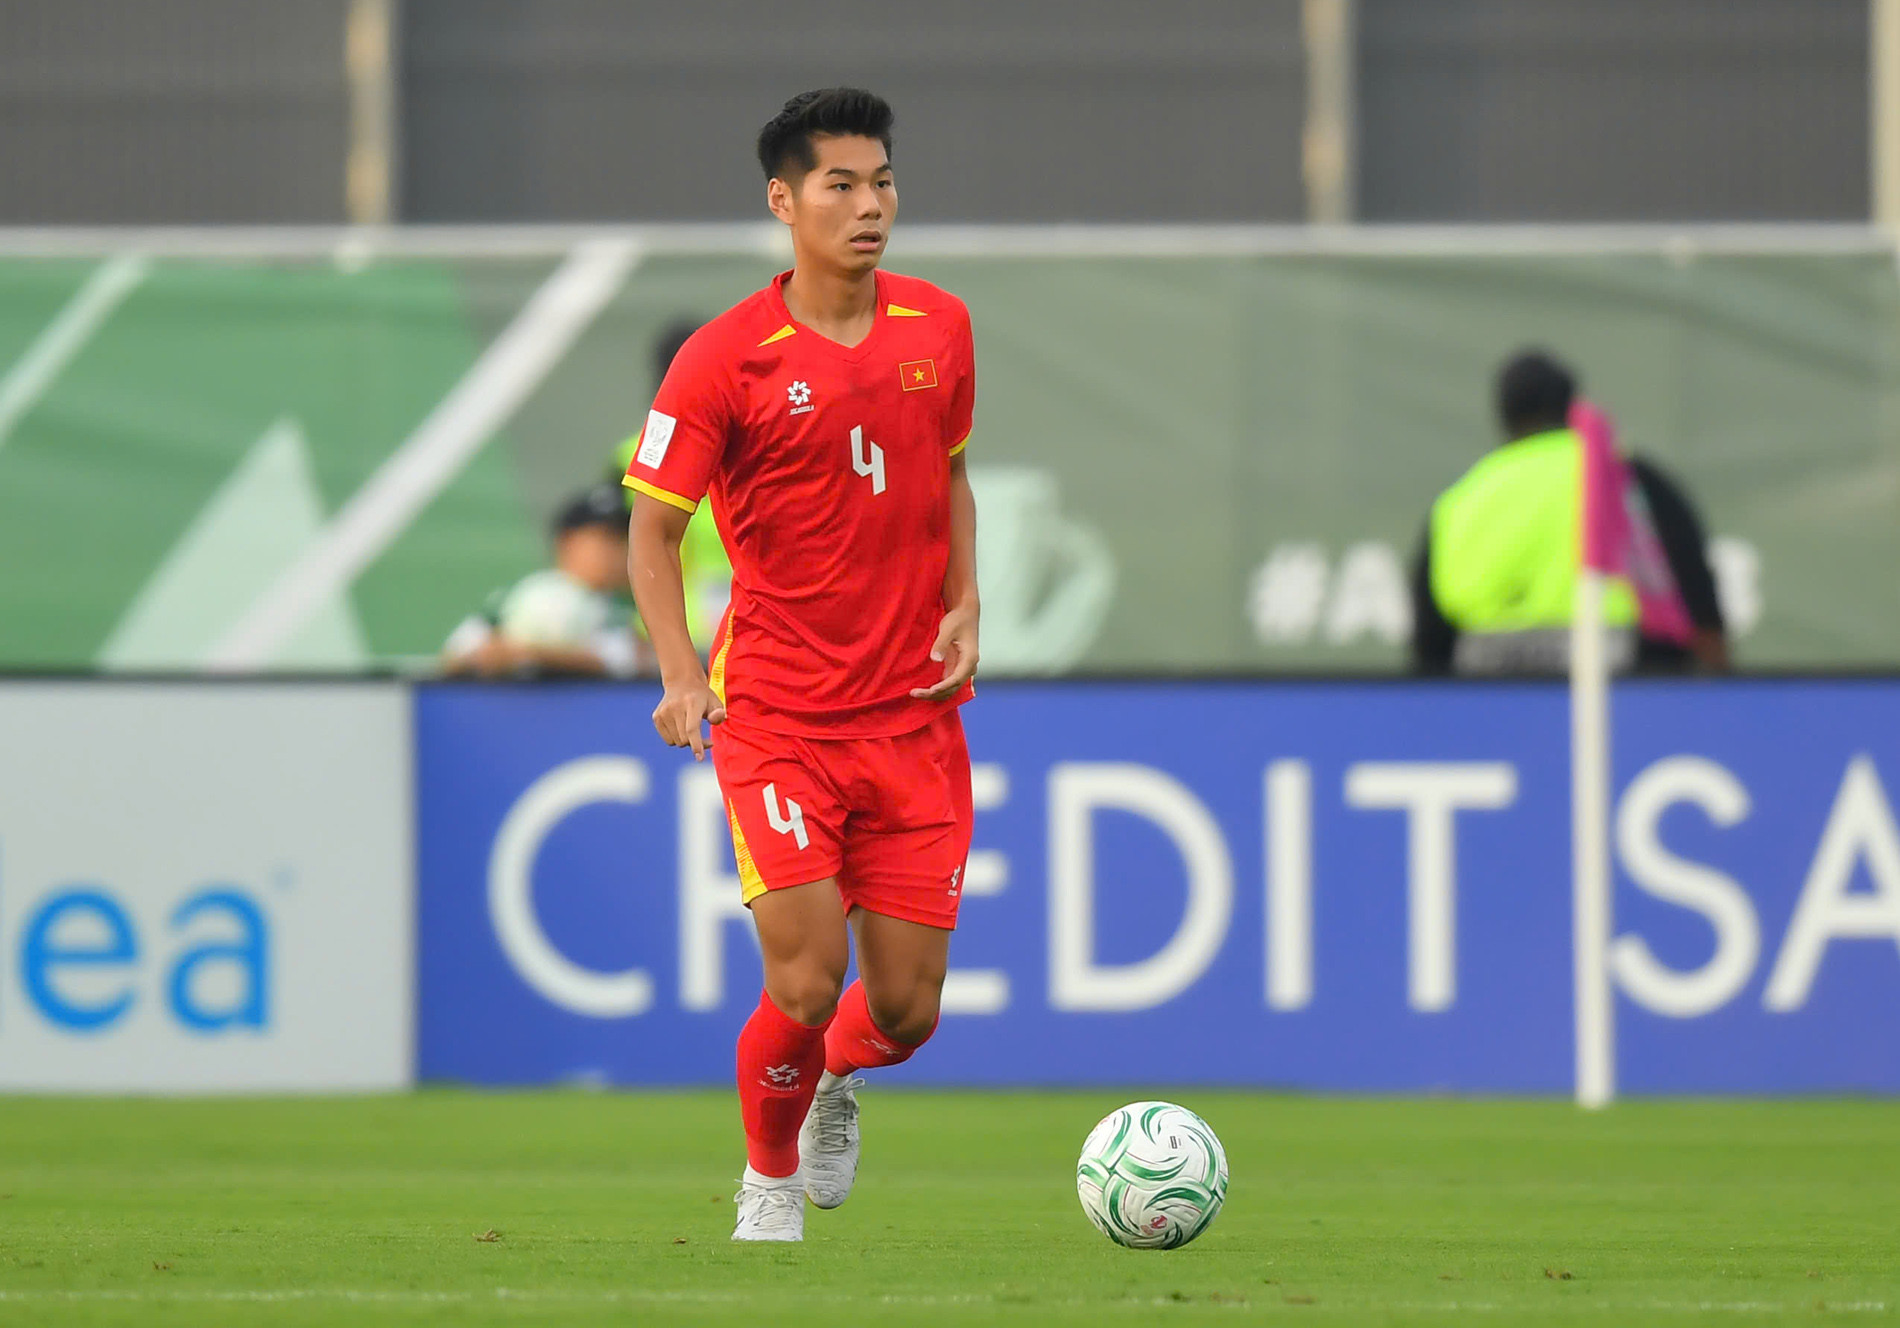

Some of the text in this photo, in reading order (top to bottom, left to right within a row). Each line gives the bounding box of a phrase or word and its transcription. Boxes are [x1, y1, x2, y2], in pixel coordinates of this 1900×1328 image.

[850, 425, 886, 496] 4
[762, 783, 810, 851] 4
[0, 838, 272, 1034] ea
